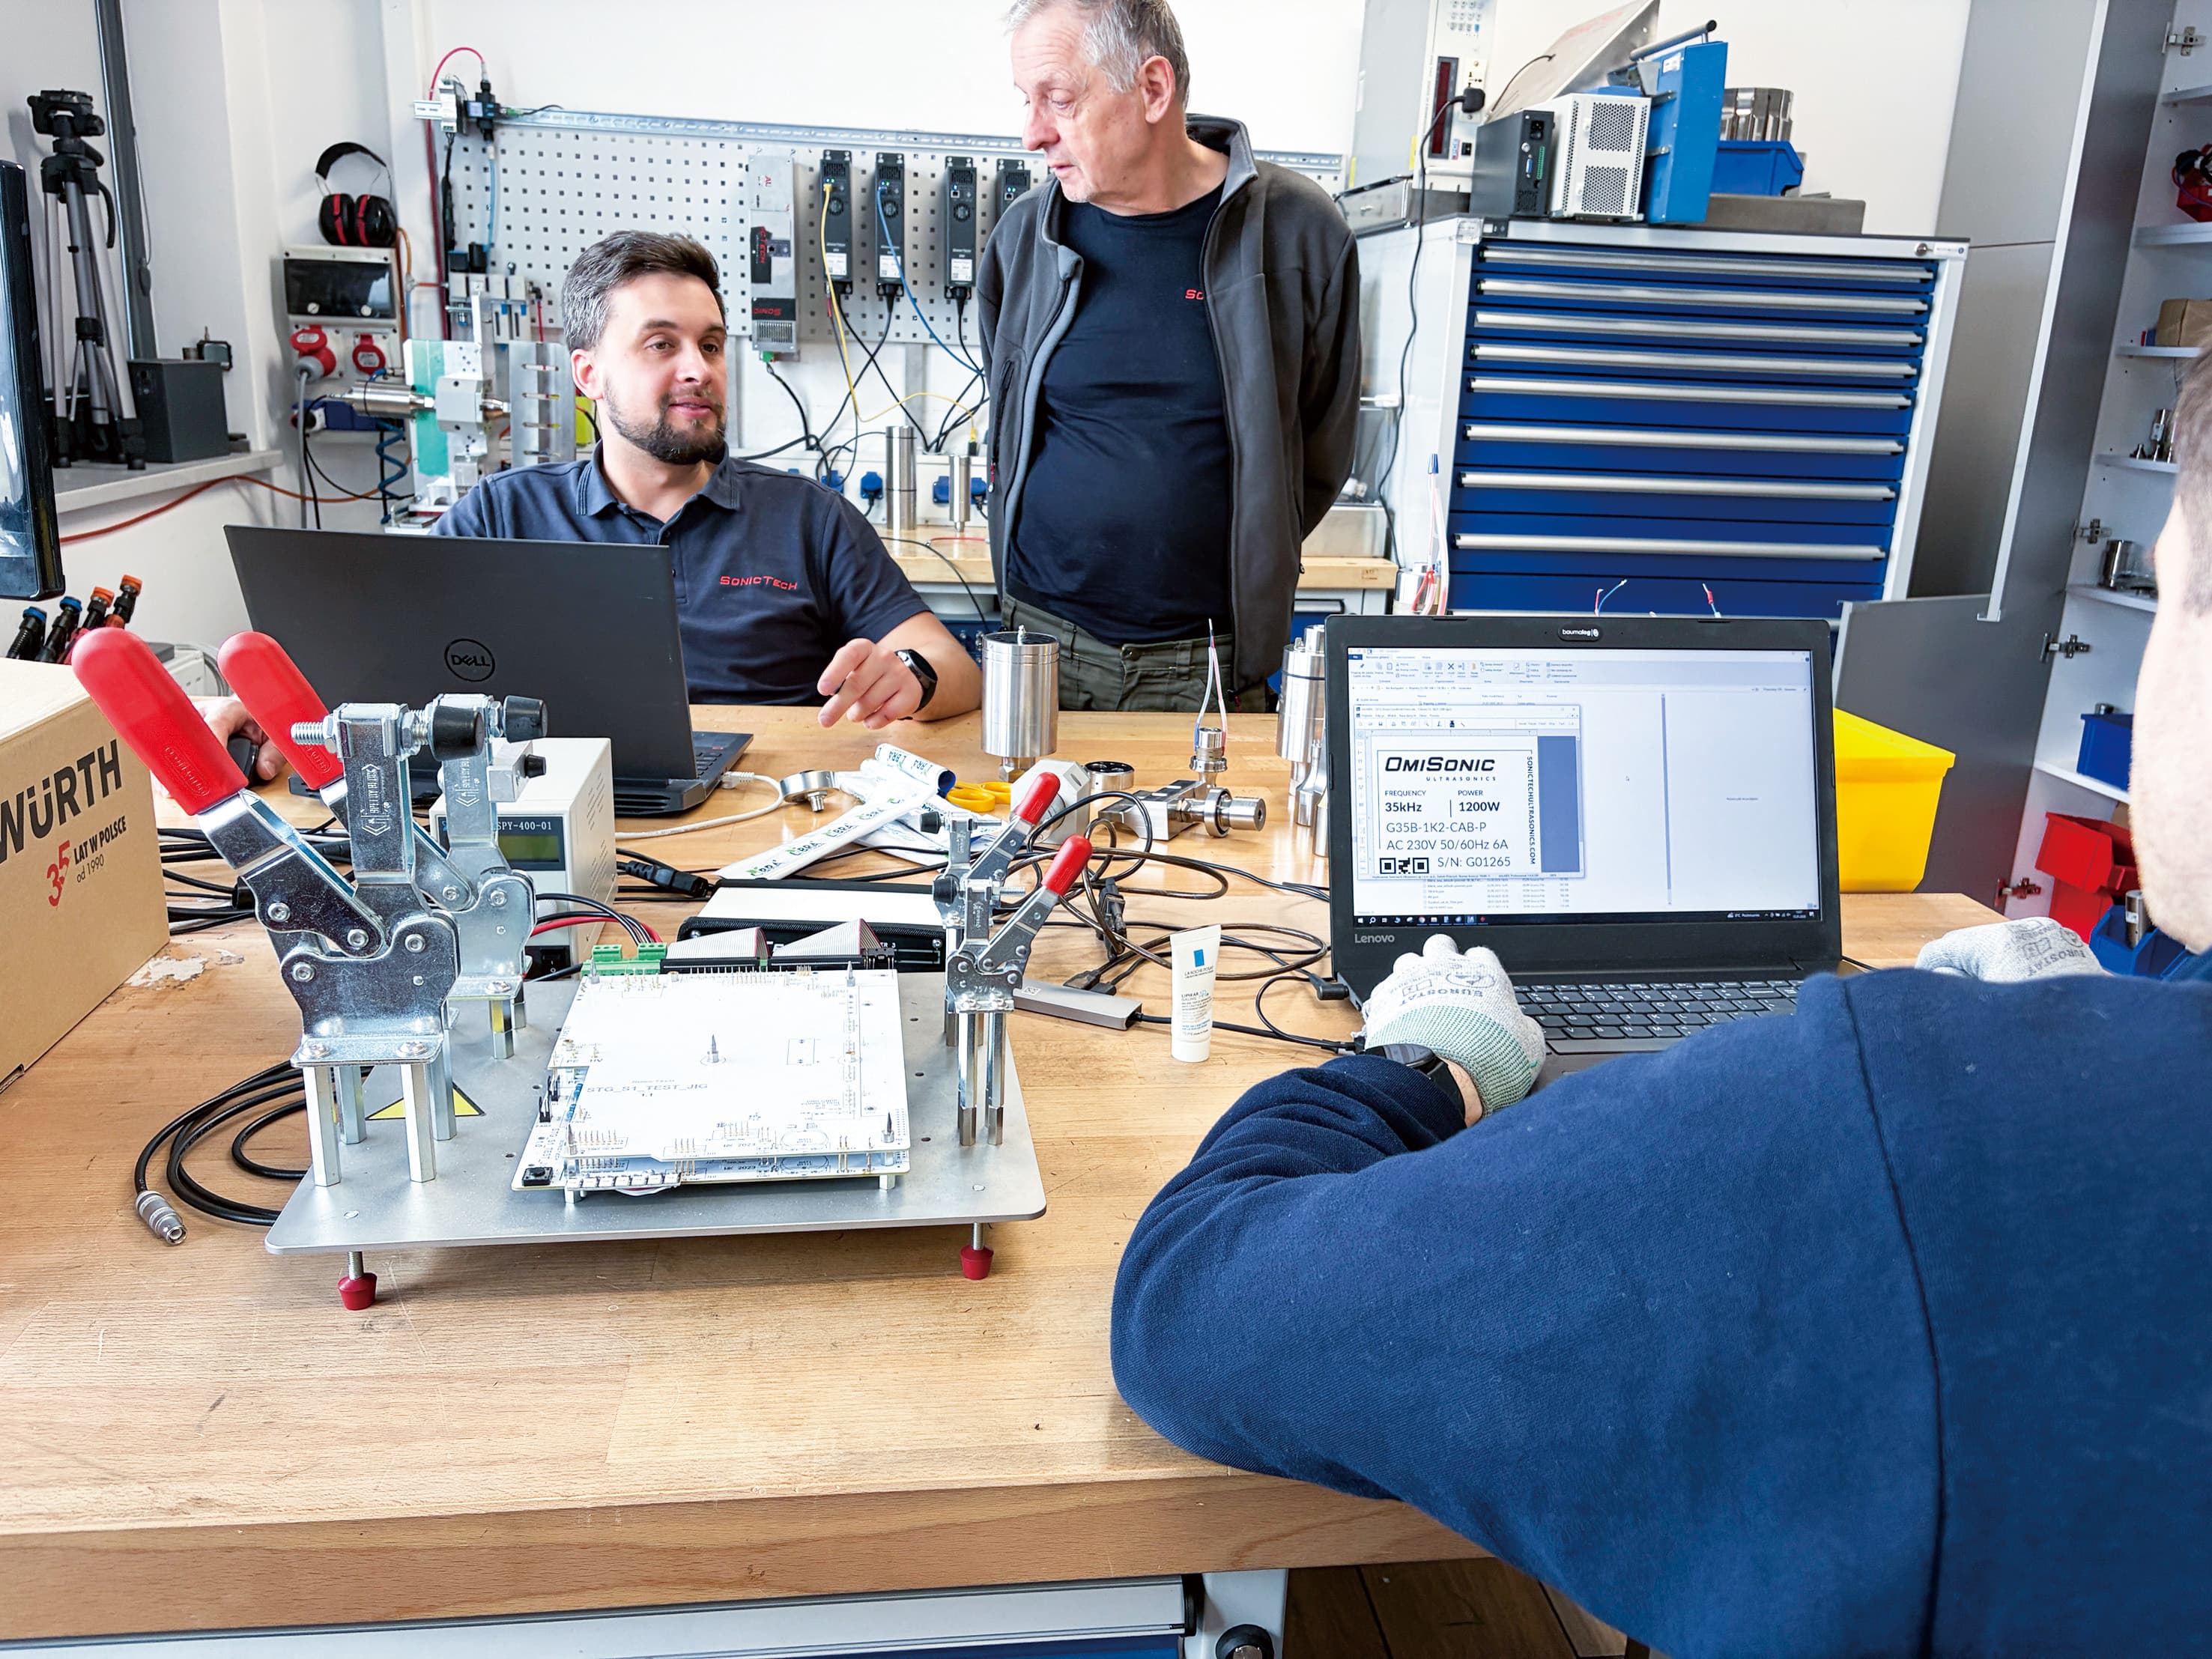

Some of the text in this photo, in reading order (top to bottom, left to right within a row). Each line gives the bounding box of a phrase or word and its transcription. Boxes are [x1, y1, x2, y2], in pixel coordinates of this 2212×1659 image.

[720, 575, 798, 590] SONICTECH
[451, 655, 491, 667] DELL
[1385, 756, 1495, 772] OMISONIC
[0, 738, 122, 864] WÜRTH
[1385, 801, 1422, 813] 35kHz
[1459, 801, 1500, 812] 1200W
[1527, 756, 1536, 865] SONICTECHULTRASONICS.COM
[1386, 822, 1487, 833] G35B-1K2-CAB-P
[73, 816, 127, 864] LAT W POLSCE
[1387, 838, 1509, 851] AC 230V 50/60Hz 6A
[76, 854, 105, 883] od 1990
[1437, 856, 1511, 868] S/N: G01265
[1354, 934, 1395, 944] Lenovo
